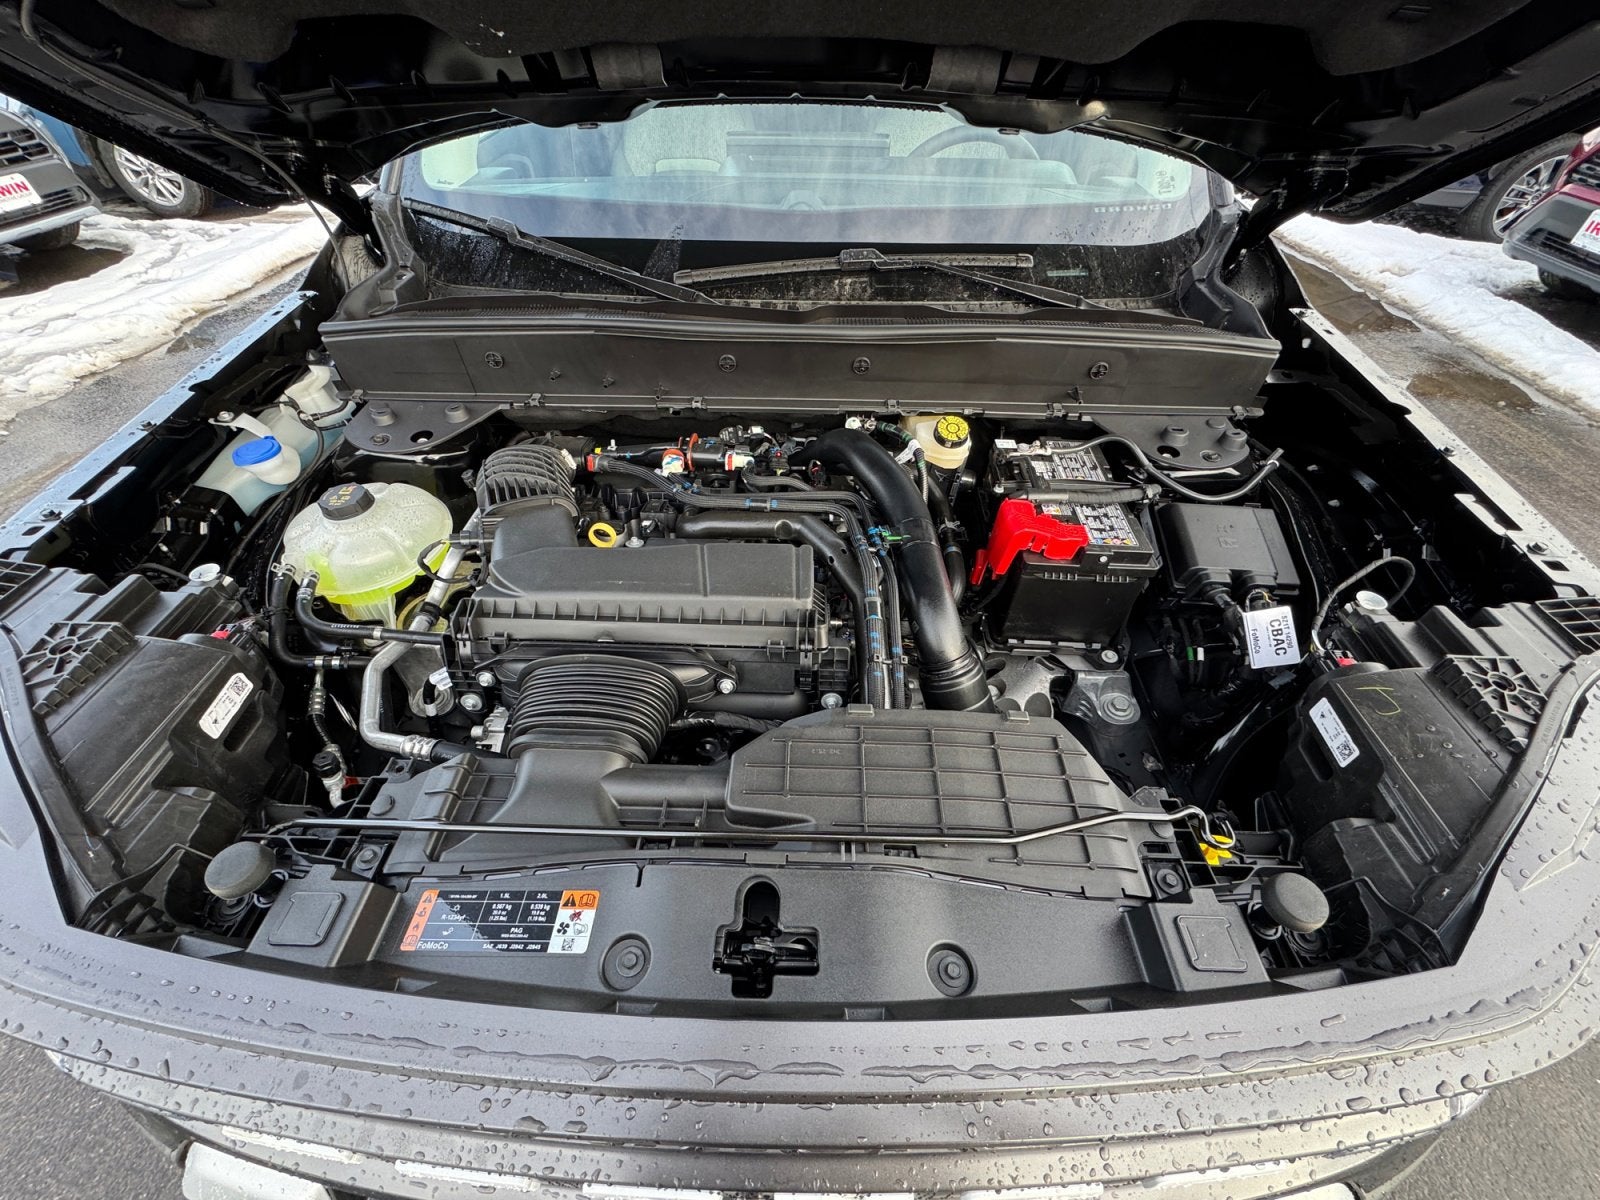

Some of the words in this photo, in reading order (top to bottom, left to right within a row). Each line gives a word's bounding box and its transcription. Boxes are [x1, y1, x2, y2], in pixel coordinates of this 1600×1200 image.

[1251, 628, 1261, 655] FoMoCo
[1269, 618, 1287, 656] CBAC
[416, 941, 449, 950] FoMoCo
